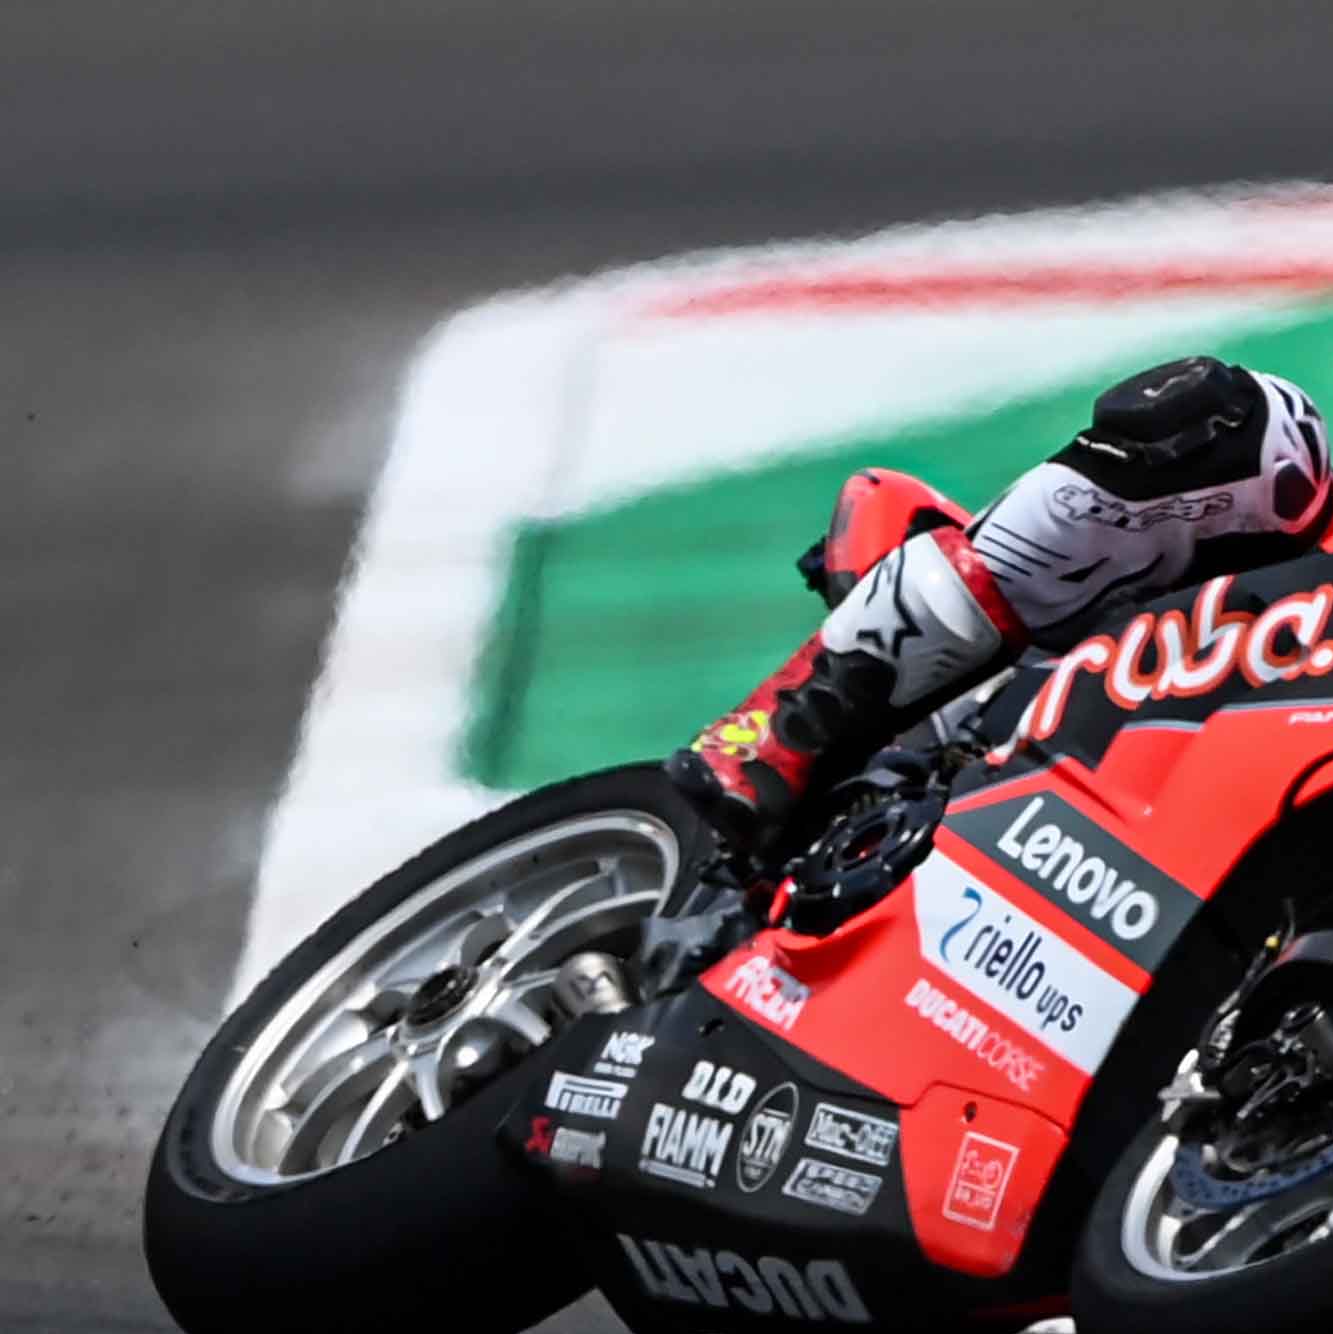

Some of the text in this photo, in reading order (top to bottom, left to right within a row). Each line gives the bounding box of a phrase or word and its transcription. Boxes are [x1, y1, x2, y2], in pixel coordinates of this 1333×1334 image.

[996, 796, 1160, 941] Lenovo
[964, 914, 1084, 1032] riello ups
[601, 1031, 655, 1065] NGK
[544, 1070, 629, 1120] PIRELLI
[641, 1102, 733, 1176] FIAMM
[617, 1233, 871, 1323] DUCATI
